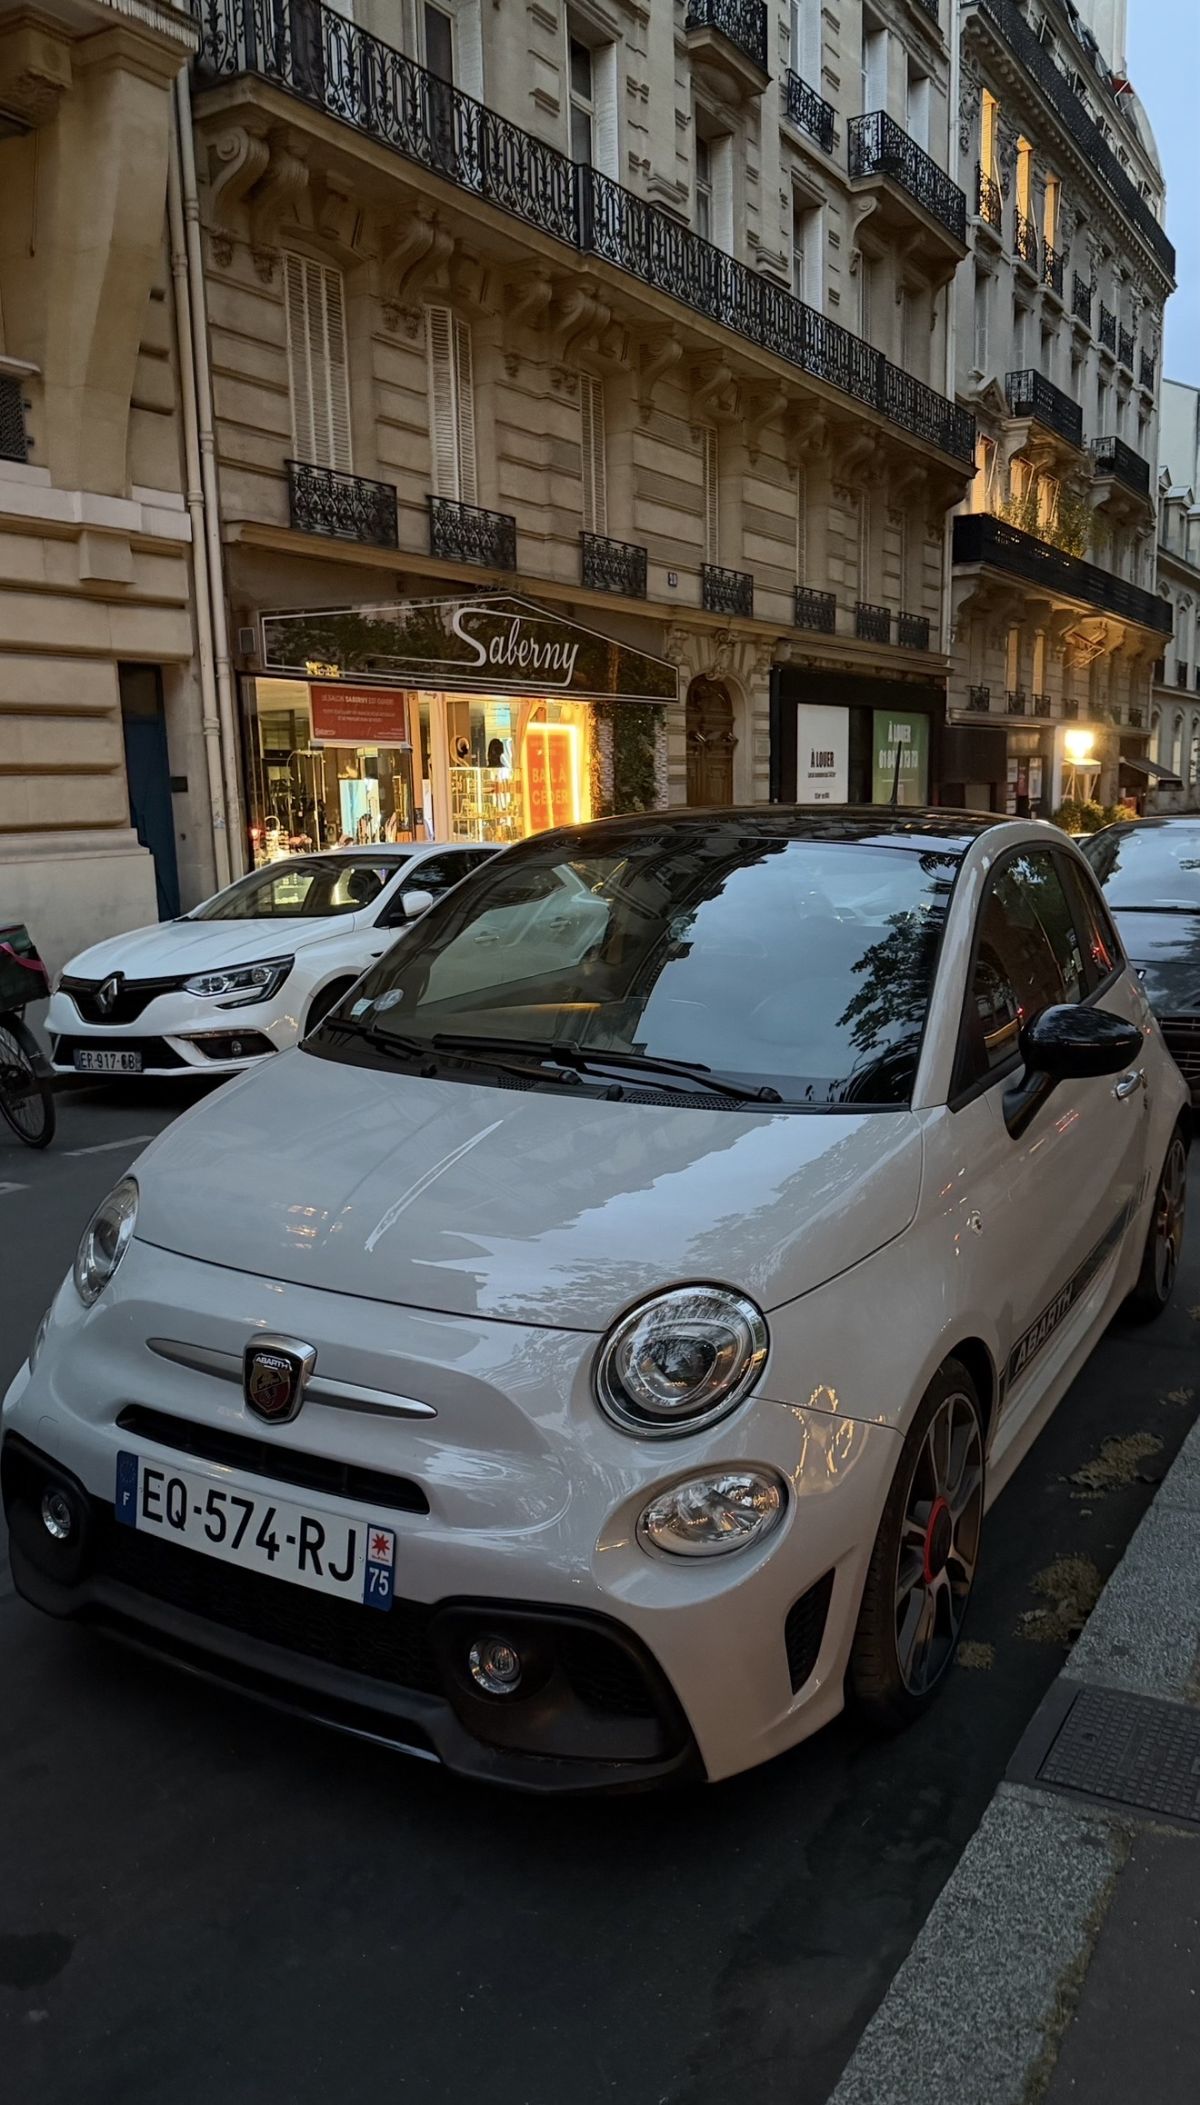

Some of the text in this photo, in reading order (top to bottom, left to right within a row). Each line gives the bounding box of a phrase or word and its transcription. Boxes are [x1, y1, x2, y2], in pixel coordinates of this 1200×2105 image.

[453, 607, 579, 687] Saberny
[816, 751, 834, 768] LOUER
[532, 768, 556, 784] BAL
[1015, 1281, 1073, 1373] ABARTH
[256, 1356, 288, 1370] ABARTH
[123, 1491, 130, 1506] F
[143, 1467, 356, 1582] EQ-574-RJ
[369, 1567, 389, 1596] 75
